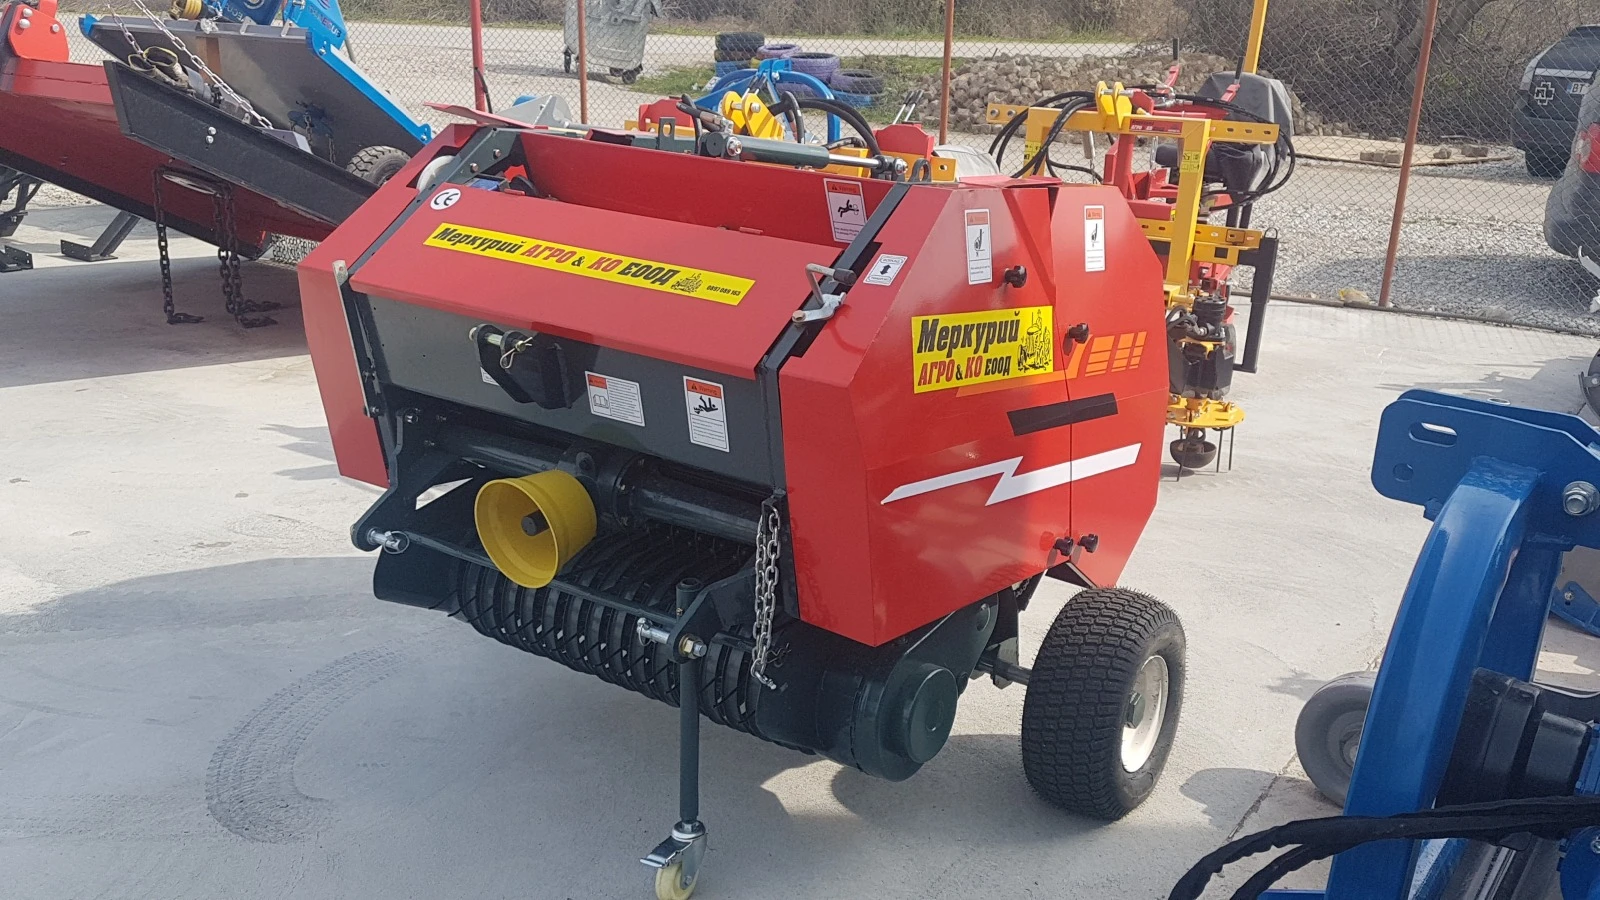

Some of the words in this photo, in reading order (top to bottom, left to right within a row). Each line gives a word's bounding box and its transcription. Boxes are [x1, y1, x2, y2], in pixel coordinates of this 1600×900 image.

[434, 192, 459, 206] CE
[433, 227, 527, 253] Меркурий
[520, 244, 577, 264] АГРО
[571, 256, 585, 267] &
[587, 256, 623, 273] КО
[616, 262, 681, 286] ЕООД
[917, 311, 1020, 358] Меркурий
[918, 359, 956, 386] АГРО
[964, 355, 983, 379] КО
[984, 356, 1011, 376] ЕООД
